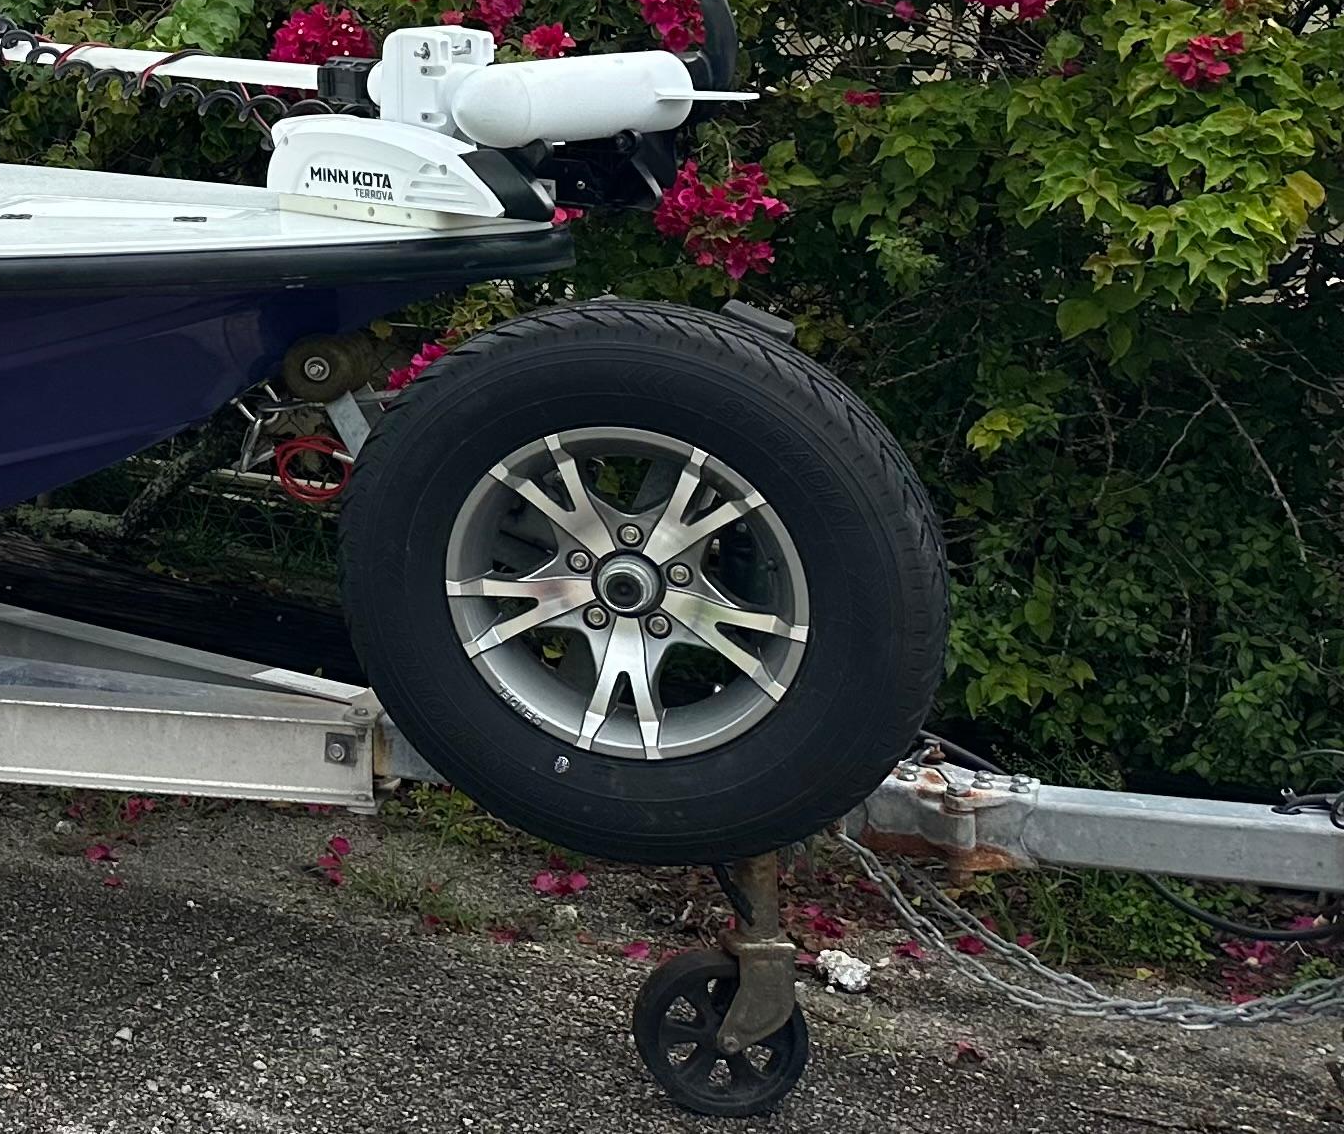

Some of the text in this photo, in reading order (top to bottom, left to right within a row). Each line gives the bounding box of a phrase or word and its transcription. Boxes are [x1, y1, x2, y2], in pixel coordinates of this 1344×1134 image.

[310, 166, 392, 189] MINN KOTA
[354, 187, 394, 201] TERROVA
[762, 425, 863, 540] RADIAL
